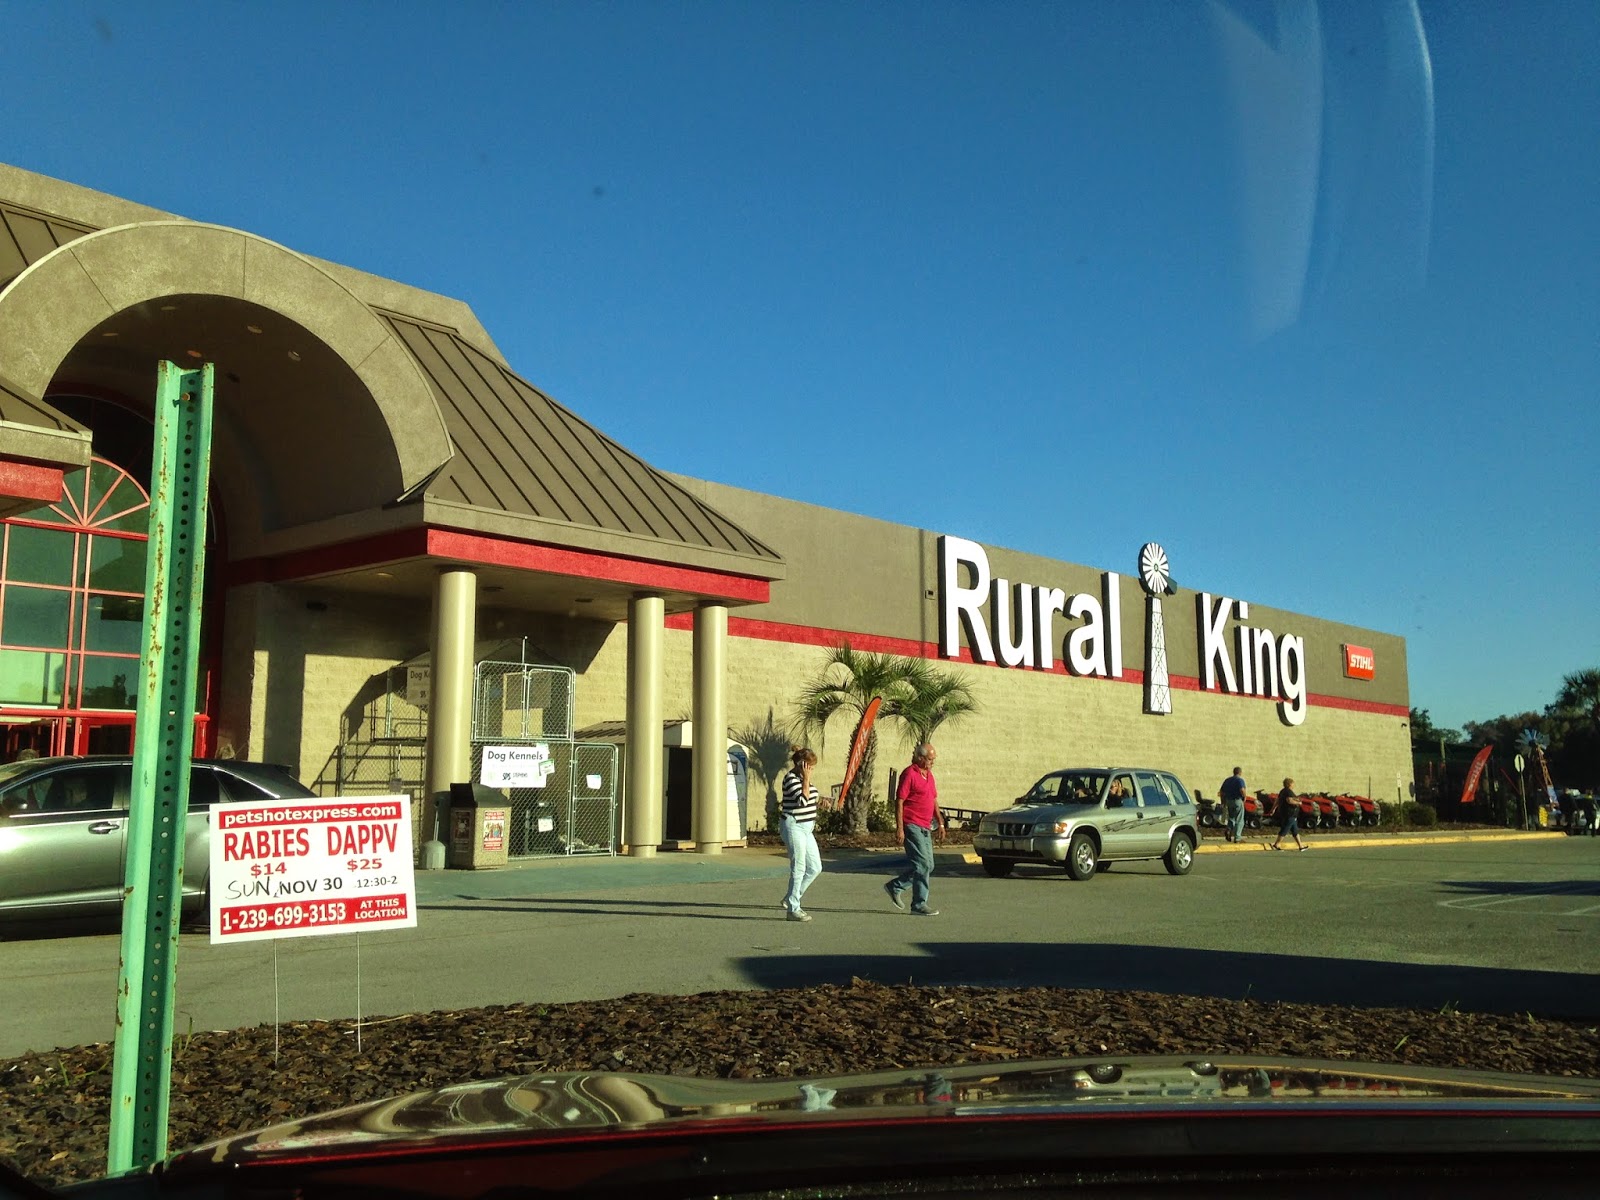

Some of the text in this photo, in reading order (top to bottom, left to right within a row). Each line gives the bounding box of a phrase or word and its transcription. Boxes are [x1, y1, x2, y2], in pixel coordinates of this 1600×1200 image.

[940, 535, 1307, 726] Rural King
[1350, 654, 1374, 670] STIHL
[410, 670, 423, 681] Dog
[488, 750, 543, 762] Dog Kennels
[224, 804, 397, 828] petshotexpress.com
[224, 822, 399, 862] RABIES DAPPV
[250, 858, 383, 878] $14 $25
[279, 878, 318, 895] NOV
[322, 876, 343, 891] 30
[355, 875, 398, 889] 12:30-2
[354, 907, 406, 919] LOCATION
[360, 897, 400, 909] AT THIS
[222, 902, 347, 931] 1-239-699-3153
